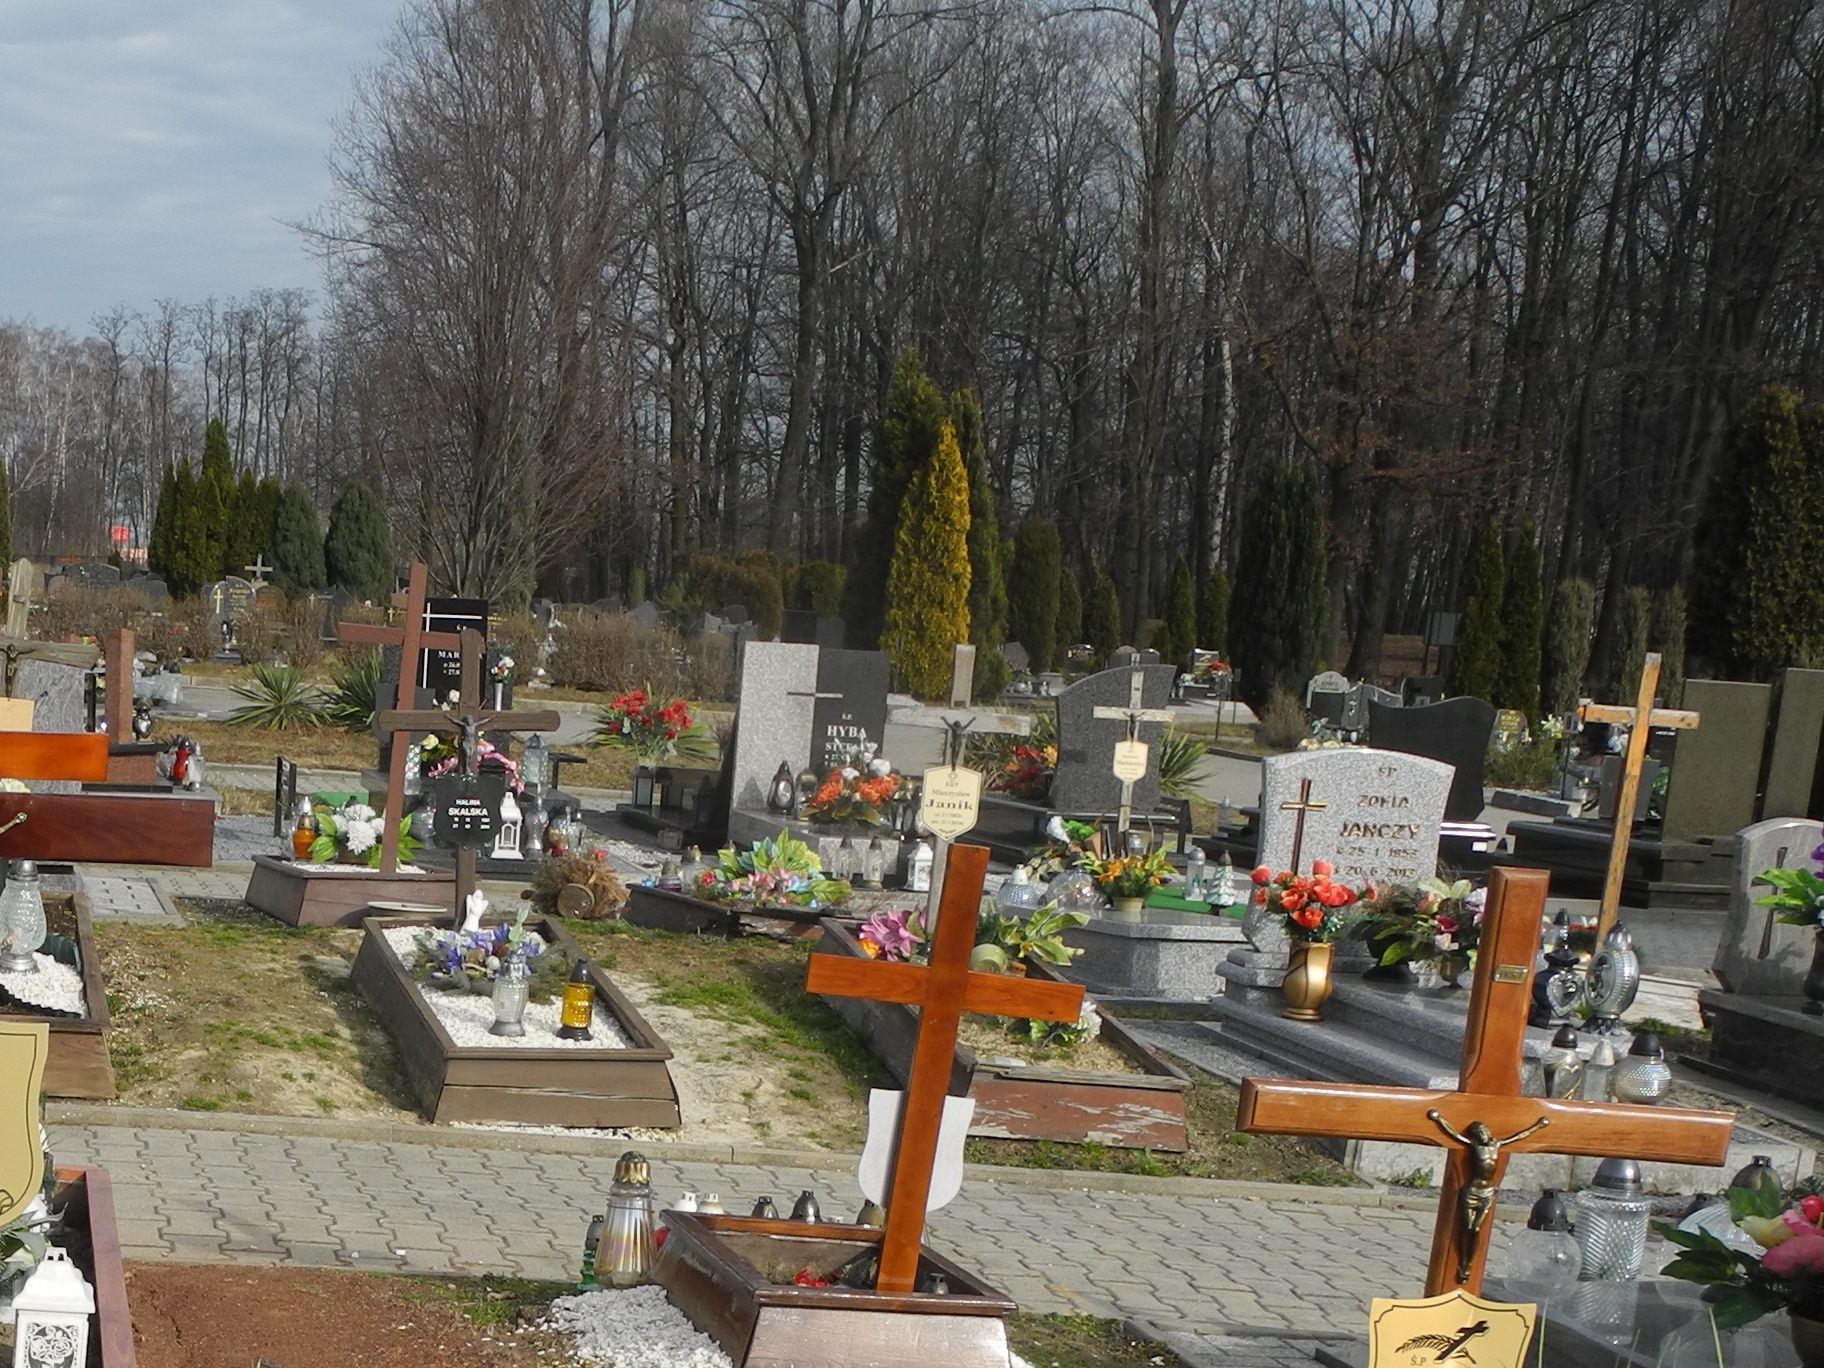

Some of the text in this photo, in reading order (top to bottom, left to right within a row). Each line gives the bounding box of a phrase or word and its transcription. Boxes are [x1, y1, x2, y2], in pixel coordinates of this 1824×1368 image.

[827, 725, 867, 738] HYBA
[925, 799, 973, 810] Janik
[1358, 794, 1409, 808] ZOFIA
[448, 807, 489, 816] SKALSKA
